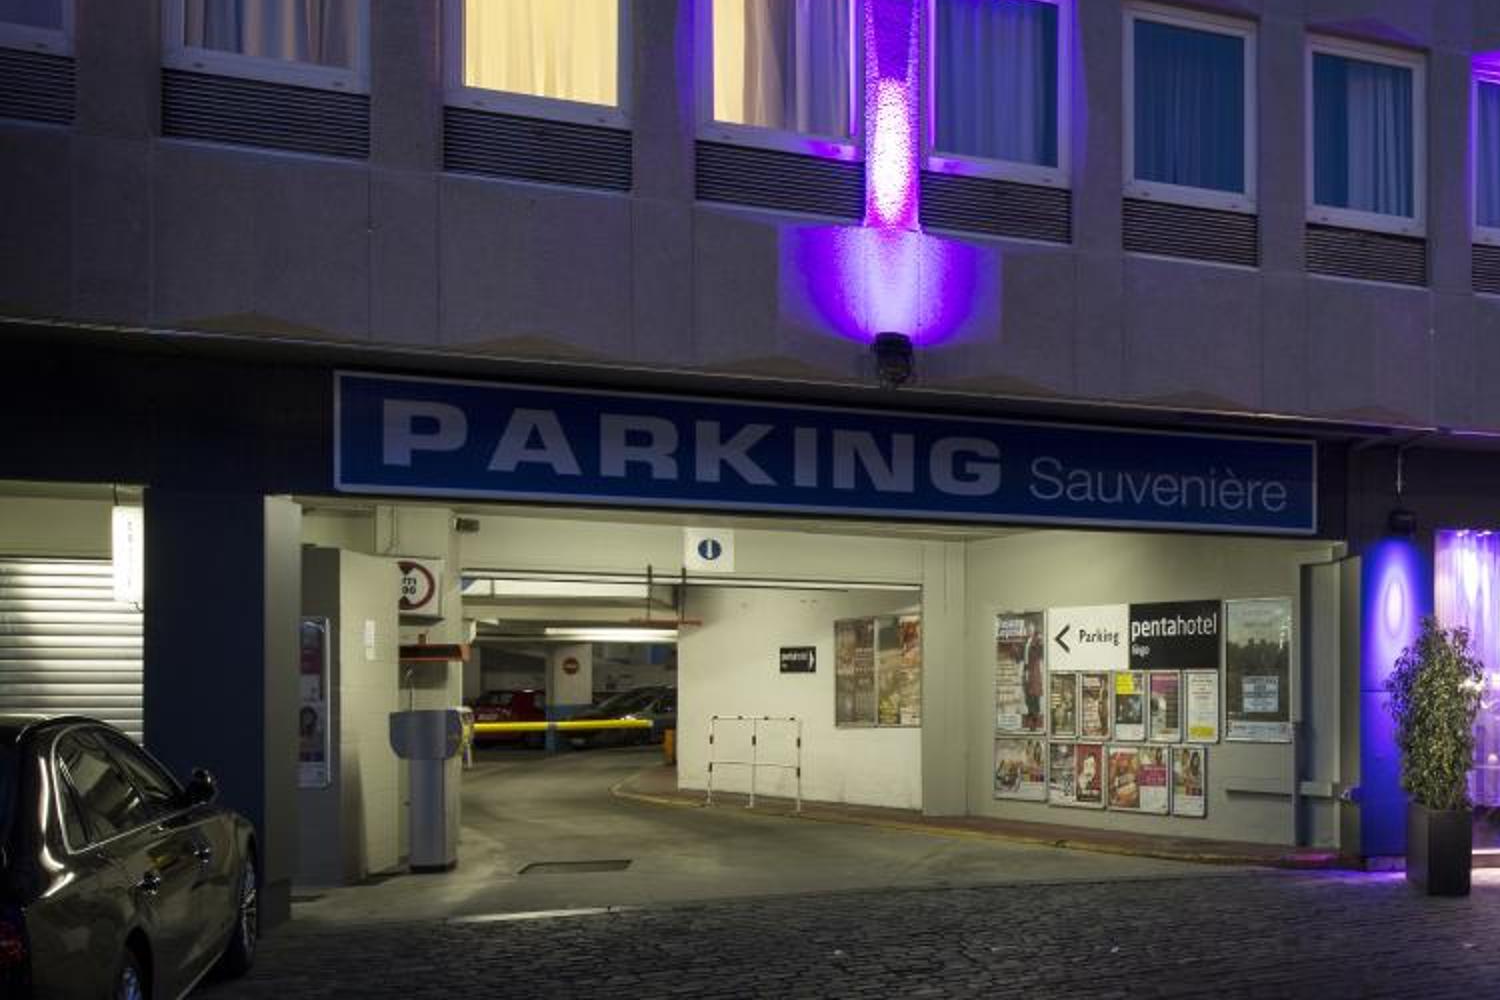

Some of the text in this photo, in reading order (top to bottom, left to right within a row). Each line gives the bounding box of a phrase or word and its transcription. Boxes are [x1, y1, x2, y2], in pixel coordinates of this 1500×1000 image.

[382, 399, 1289, 512] PARKING Sauvenière
[1078, 628, 1121, 647] Parking
[1131, 613, 1218, 642] pentahotel
